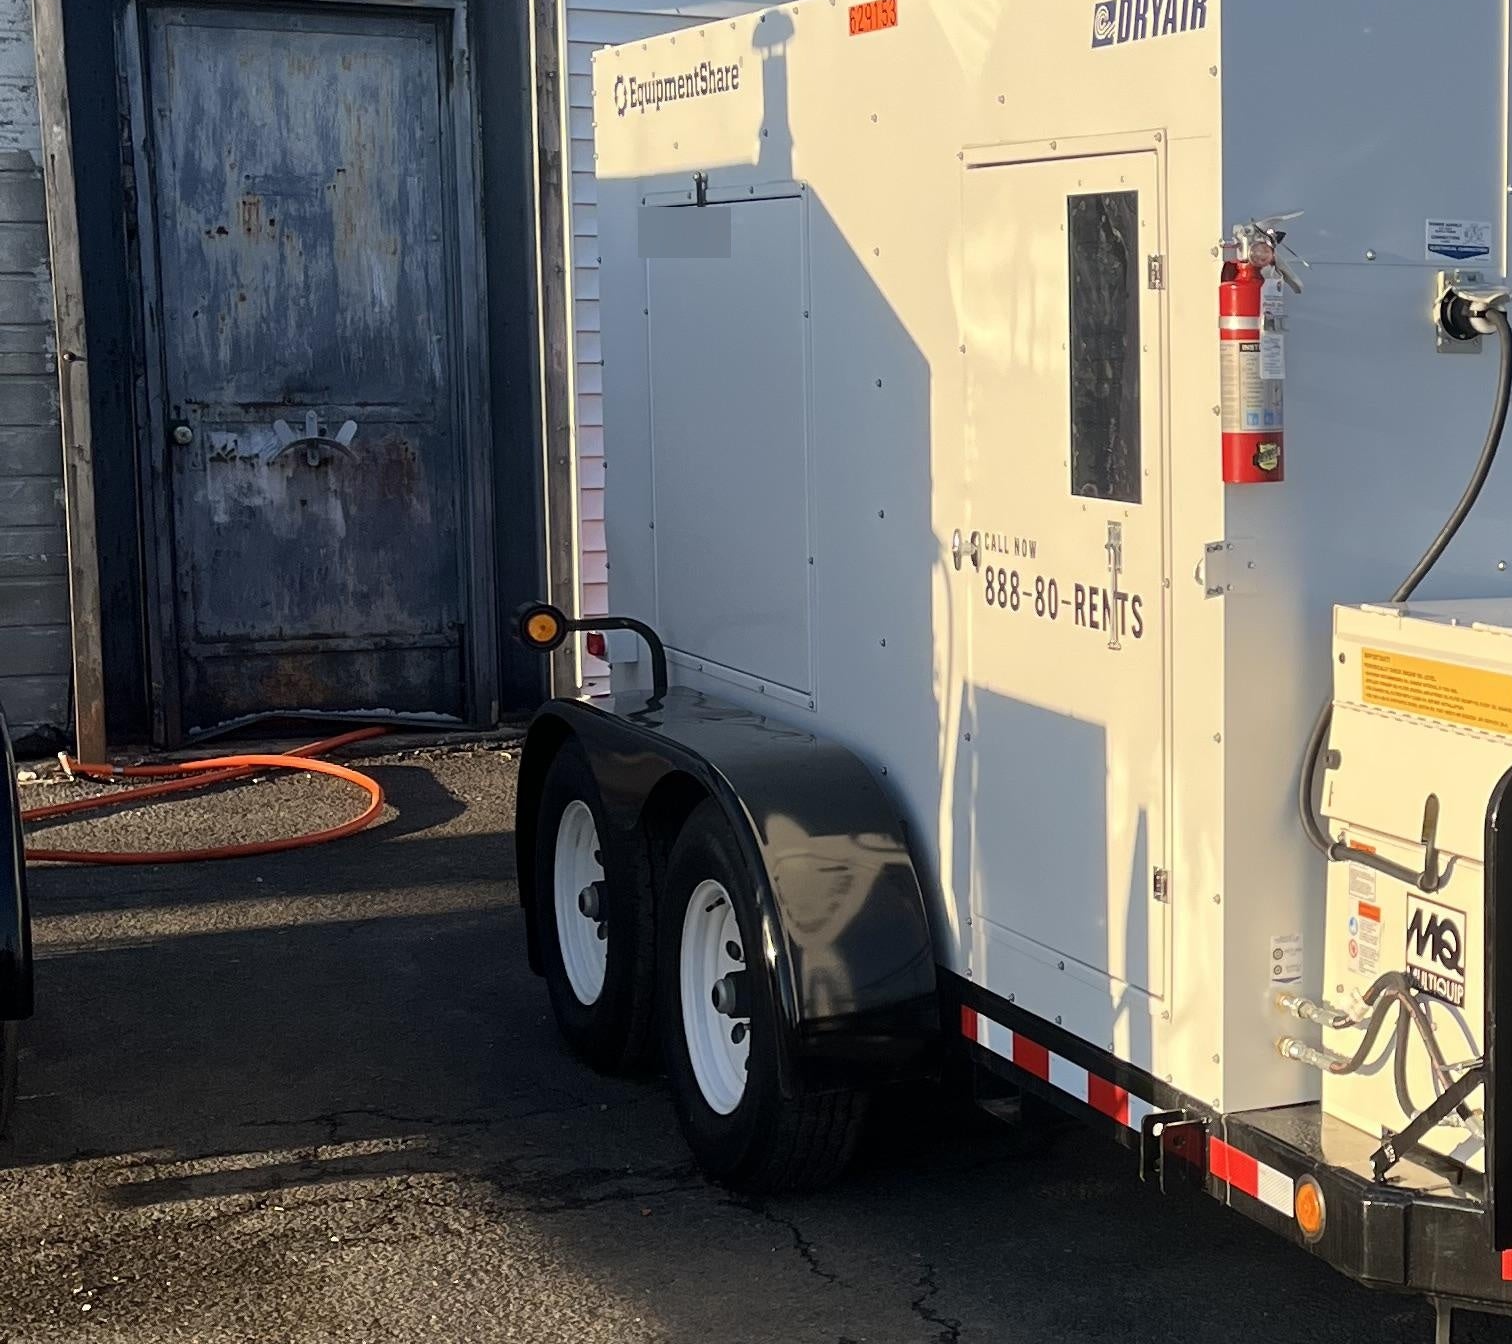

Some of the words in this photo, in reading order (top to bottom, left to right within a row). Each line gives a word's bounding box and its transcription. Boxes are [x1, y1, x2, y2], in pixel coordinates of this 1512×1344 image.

[628, 60, 740, 114] EquipmentShare
[983, 531, 1010, 555] CALL
[1014, 537, 1038, 559] NOW
[1406, 907, 1465, 978] MQ
